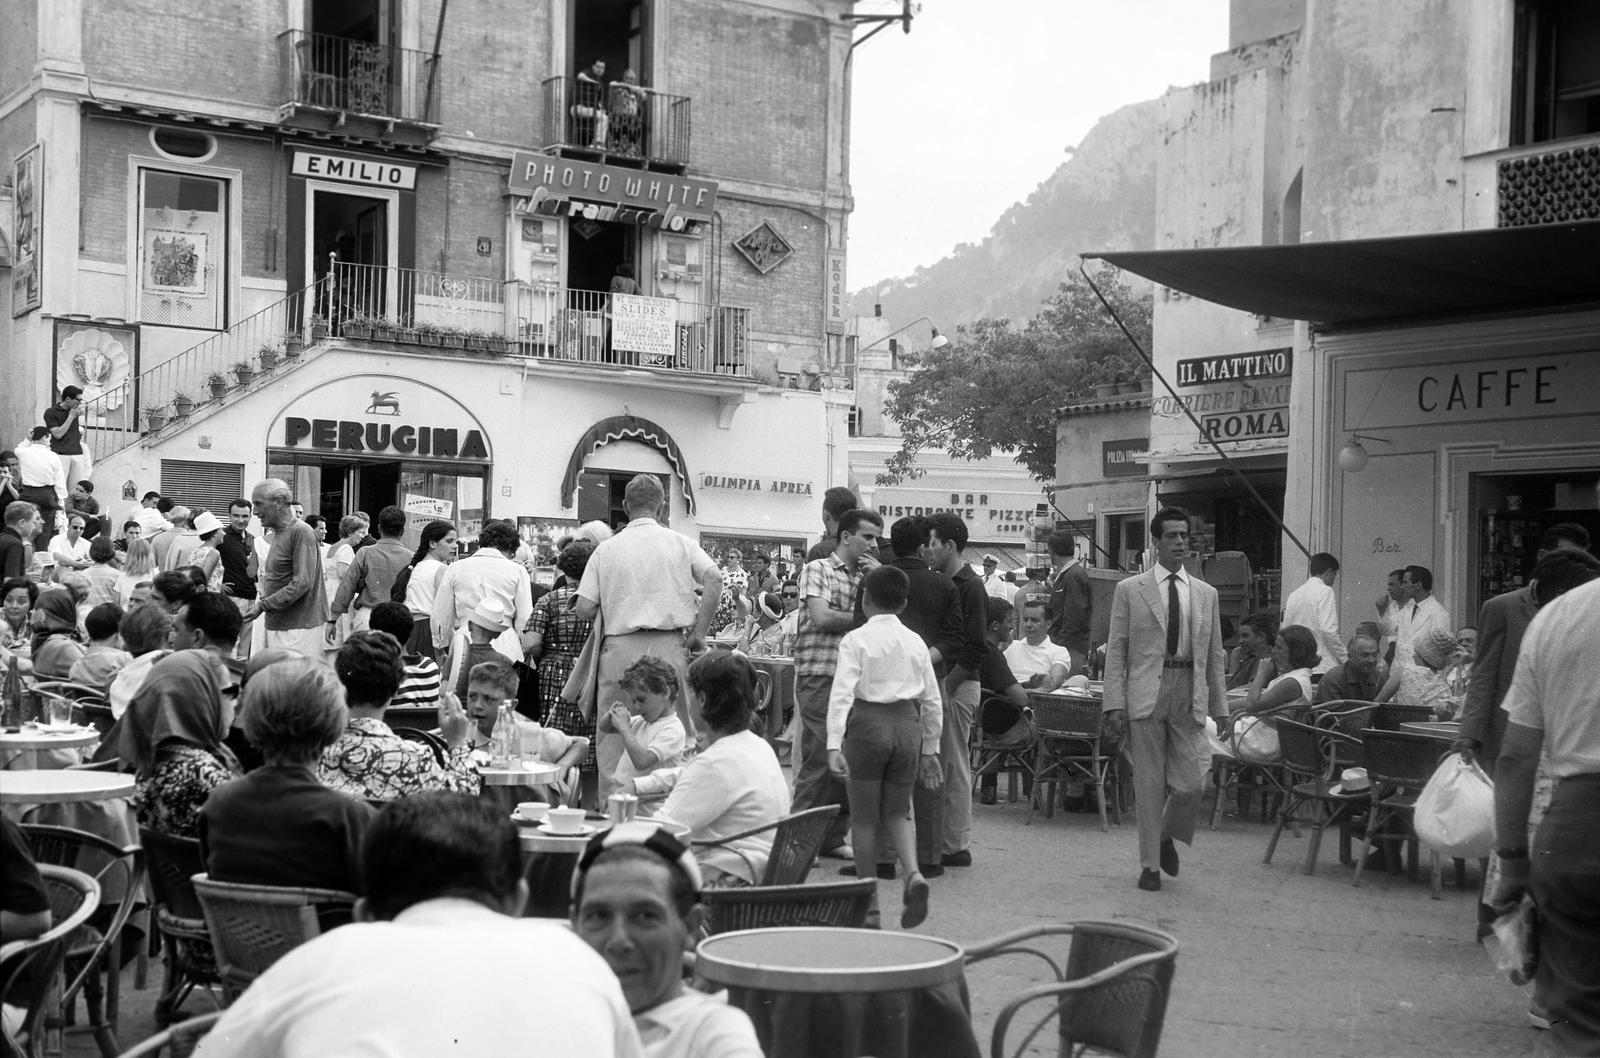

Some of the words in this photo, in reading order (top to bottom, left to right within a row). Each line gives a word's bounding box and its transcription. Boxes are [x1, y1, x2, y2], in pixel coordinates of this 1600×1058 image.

[308, 156, 401, 184] EMILIO
[525, 161, 611, 193] PHOTO
[625, 177, 709, 208] WHITE
[832, 258, 842, 319] Kodak
[620, 303, 667, 317] SLIDES
[1179, 363, 1198, 384] IL
[1202, 355, 1287, 381] MATTINO
[1152, 391, 1235, 416] CORRIERE
[285, 416, 489, 459] PERUGINA
[1204, 412, 1286, 440] ROMA
[704, 475, 762, 491] OLIMPIA
[951, 493, 989, 505] BAR
[1371, 536, 1402, 554] Bar
